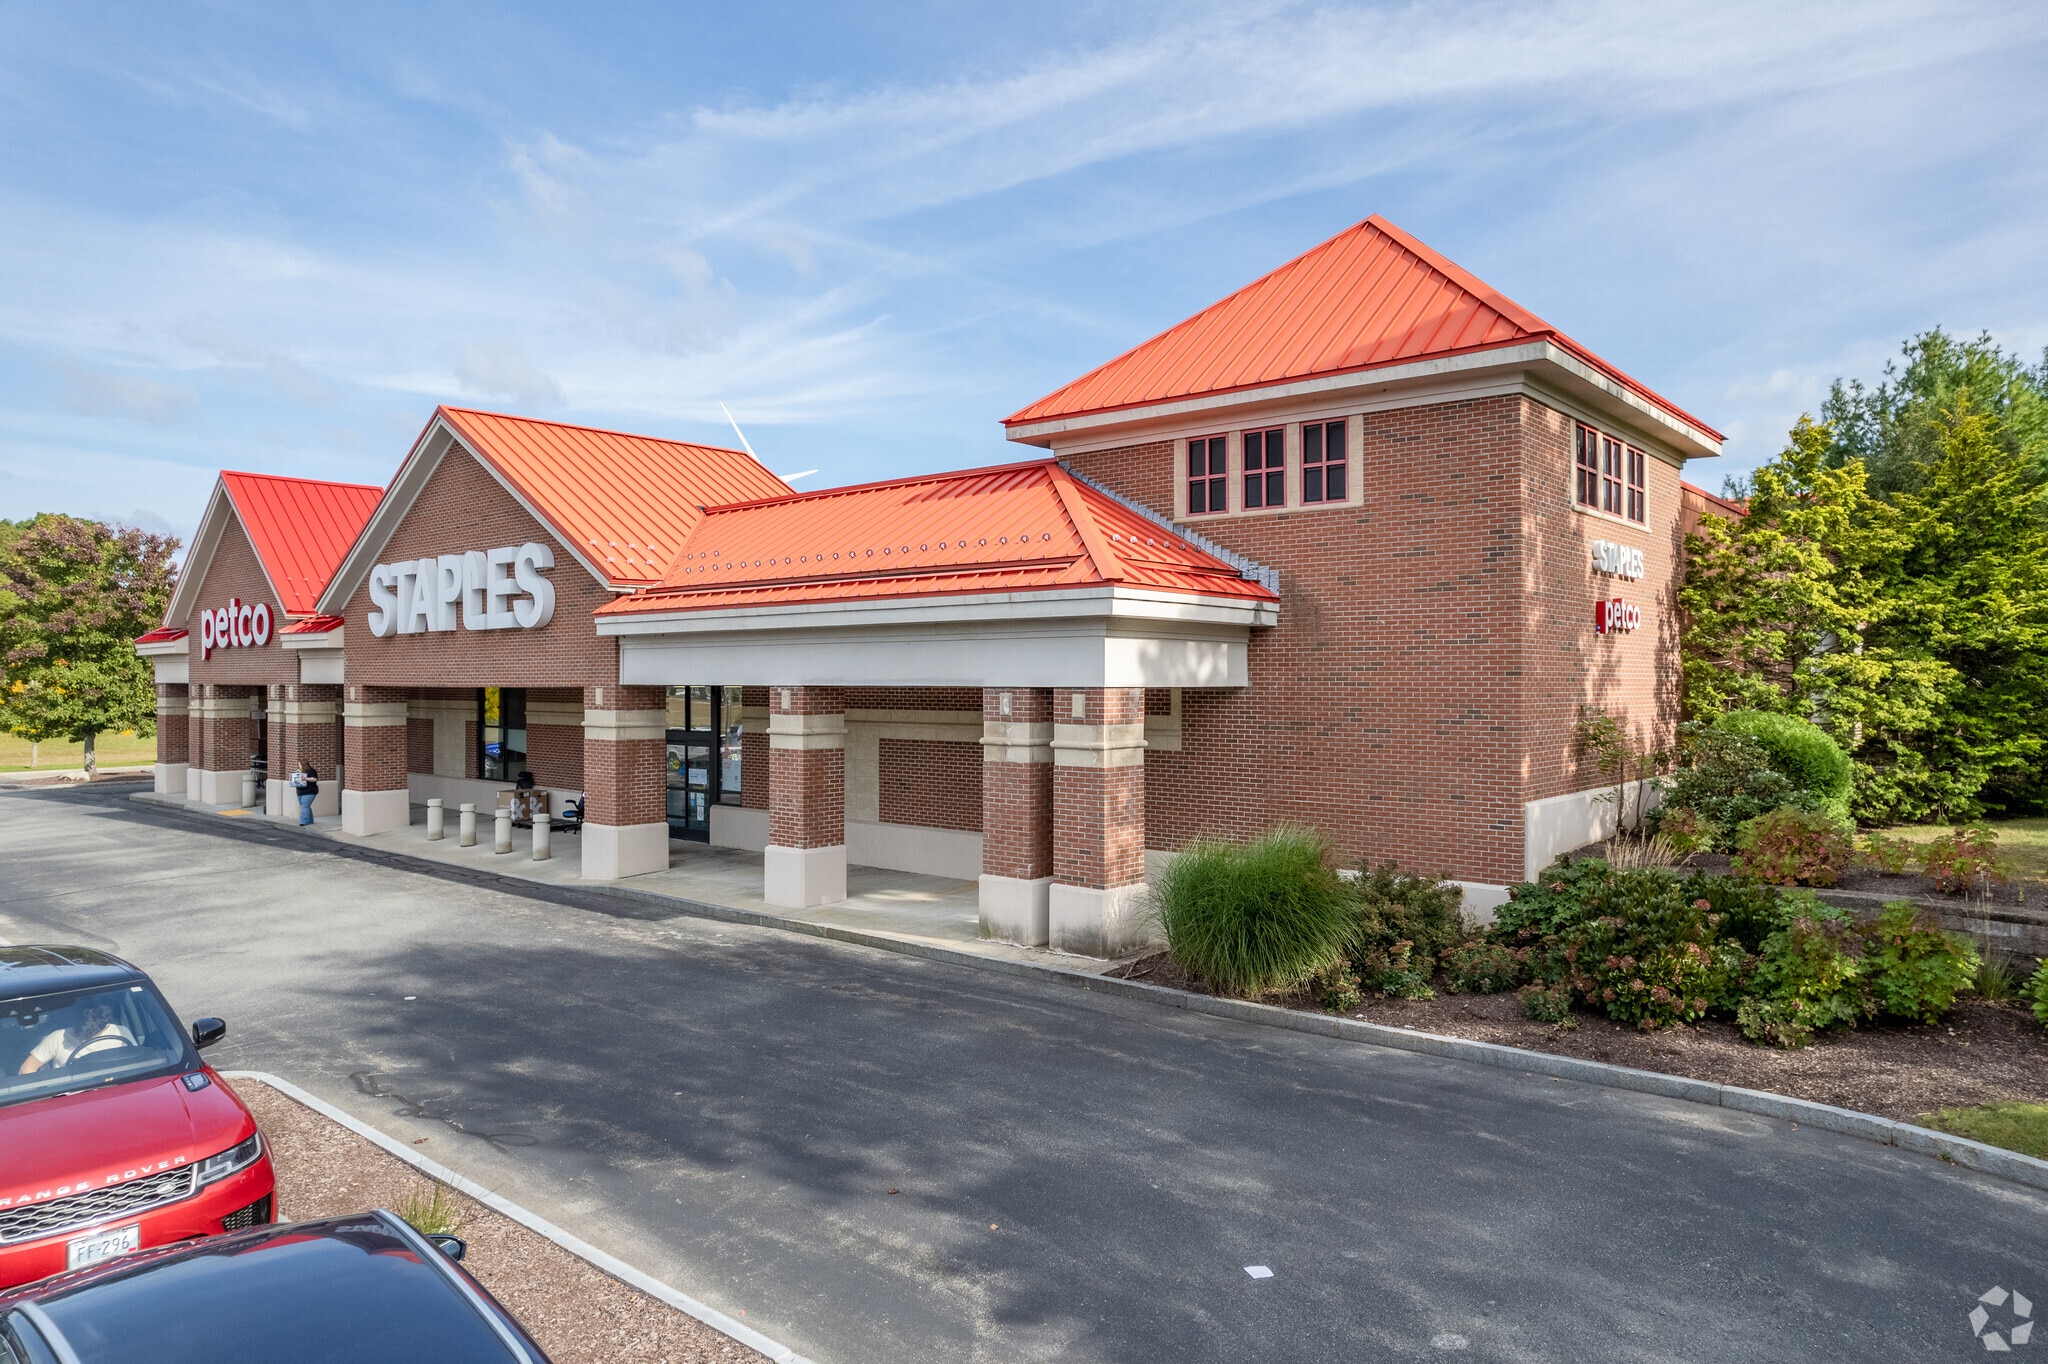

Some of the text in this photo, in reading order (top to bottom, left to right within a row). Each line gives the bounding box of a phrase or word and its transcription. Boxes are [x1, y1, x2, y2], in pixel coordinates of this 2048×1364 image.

[1593, 540, 1644, 579] STAPLES
[368, 542, 556, 638] STAPLES
[202, 598, 273, 661] petco
[1602, 598, 1641, 635] petco
[106, 1155, 186, 1184] ROVER
[77, 1235, 130, 1262] FF-296
